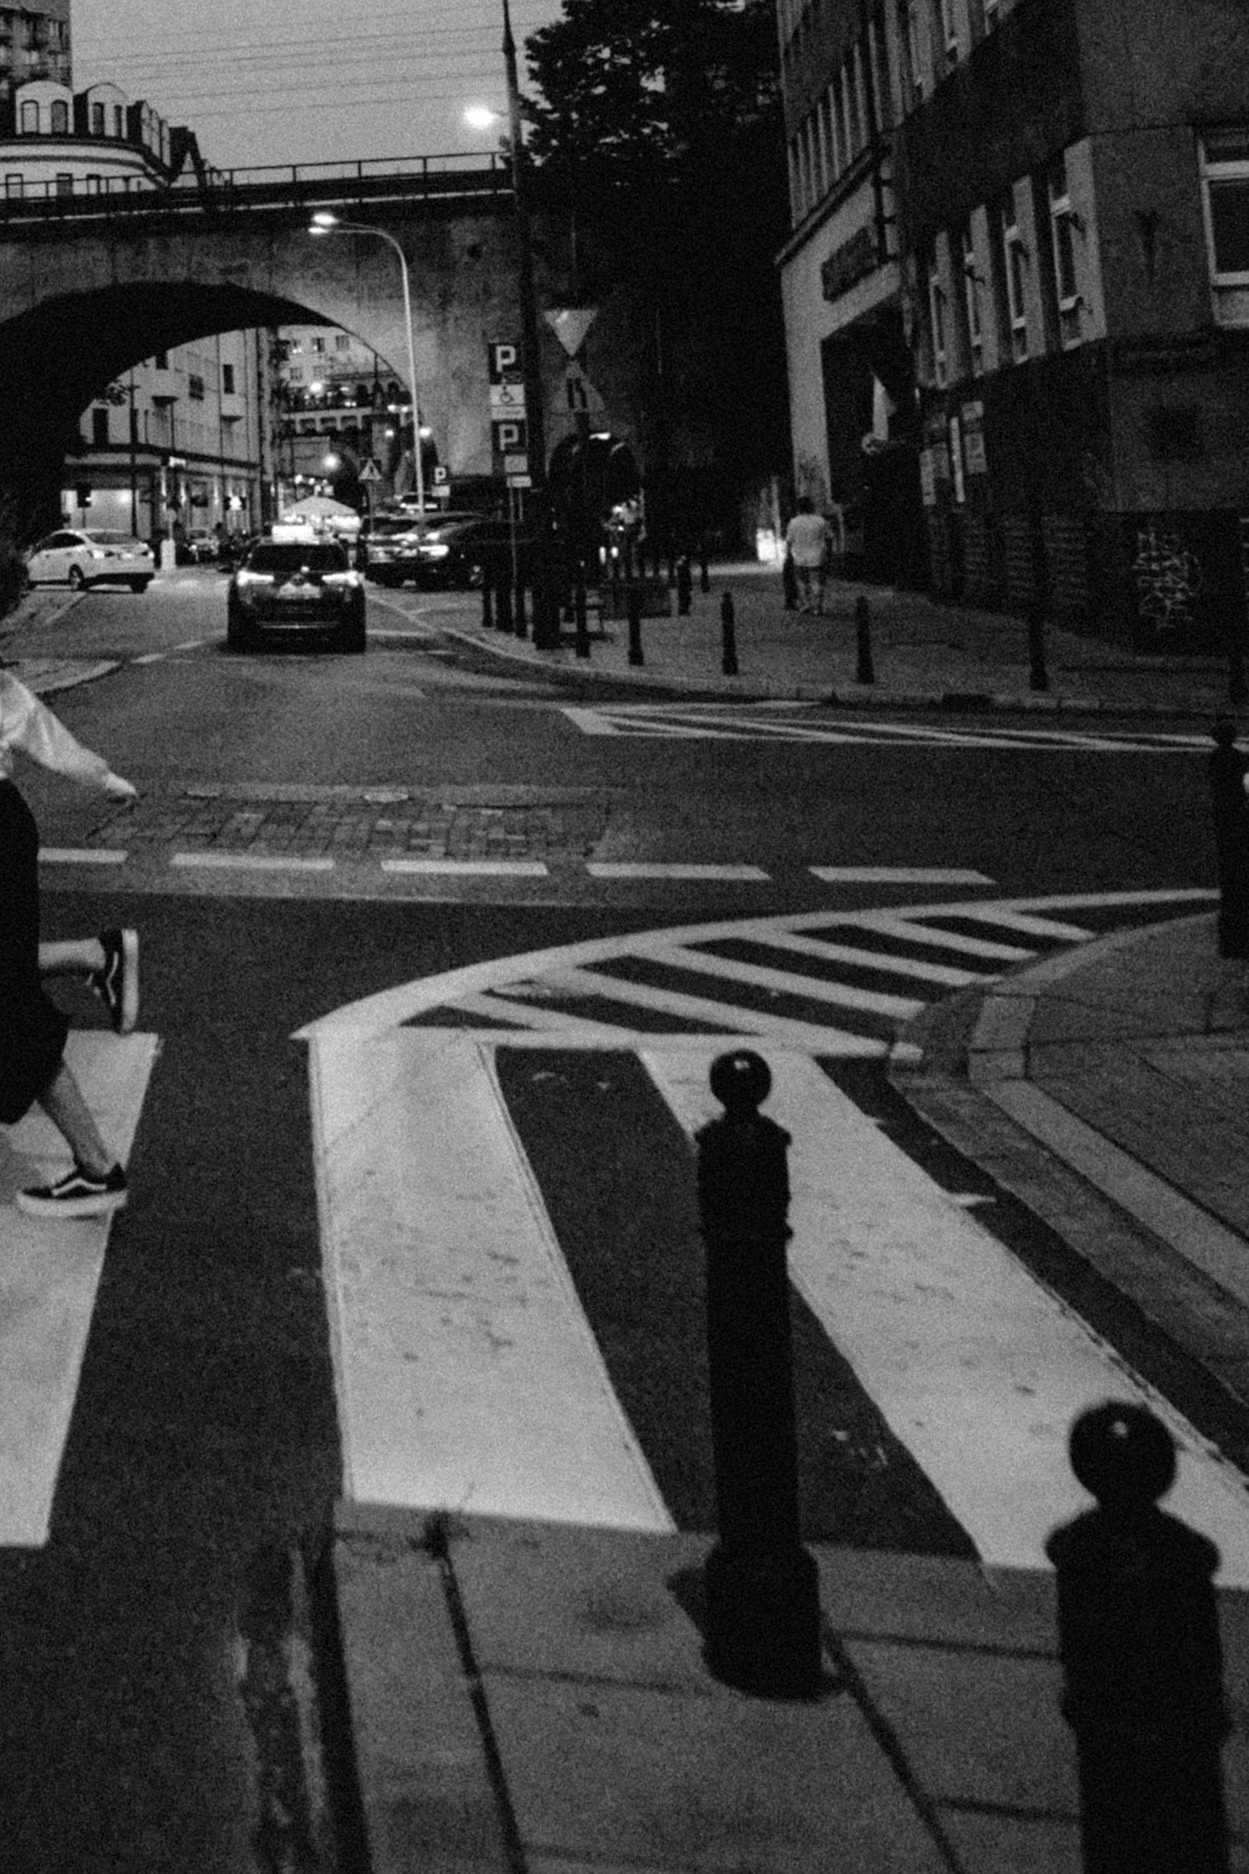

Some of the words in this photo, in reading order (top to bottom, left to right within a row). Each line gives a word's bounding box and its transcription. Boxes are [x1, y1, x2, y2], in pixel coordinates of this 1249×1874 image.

[496, 345, 517, 373] P
[499, 424, 519, 451] P
[434, 466, 447, 484] P
